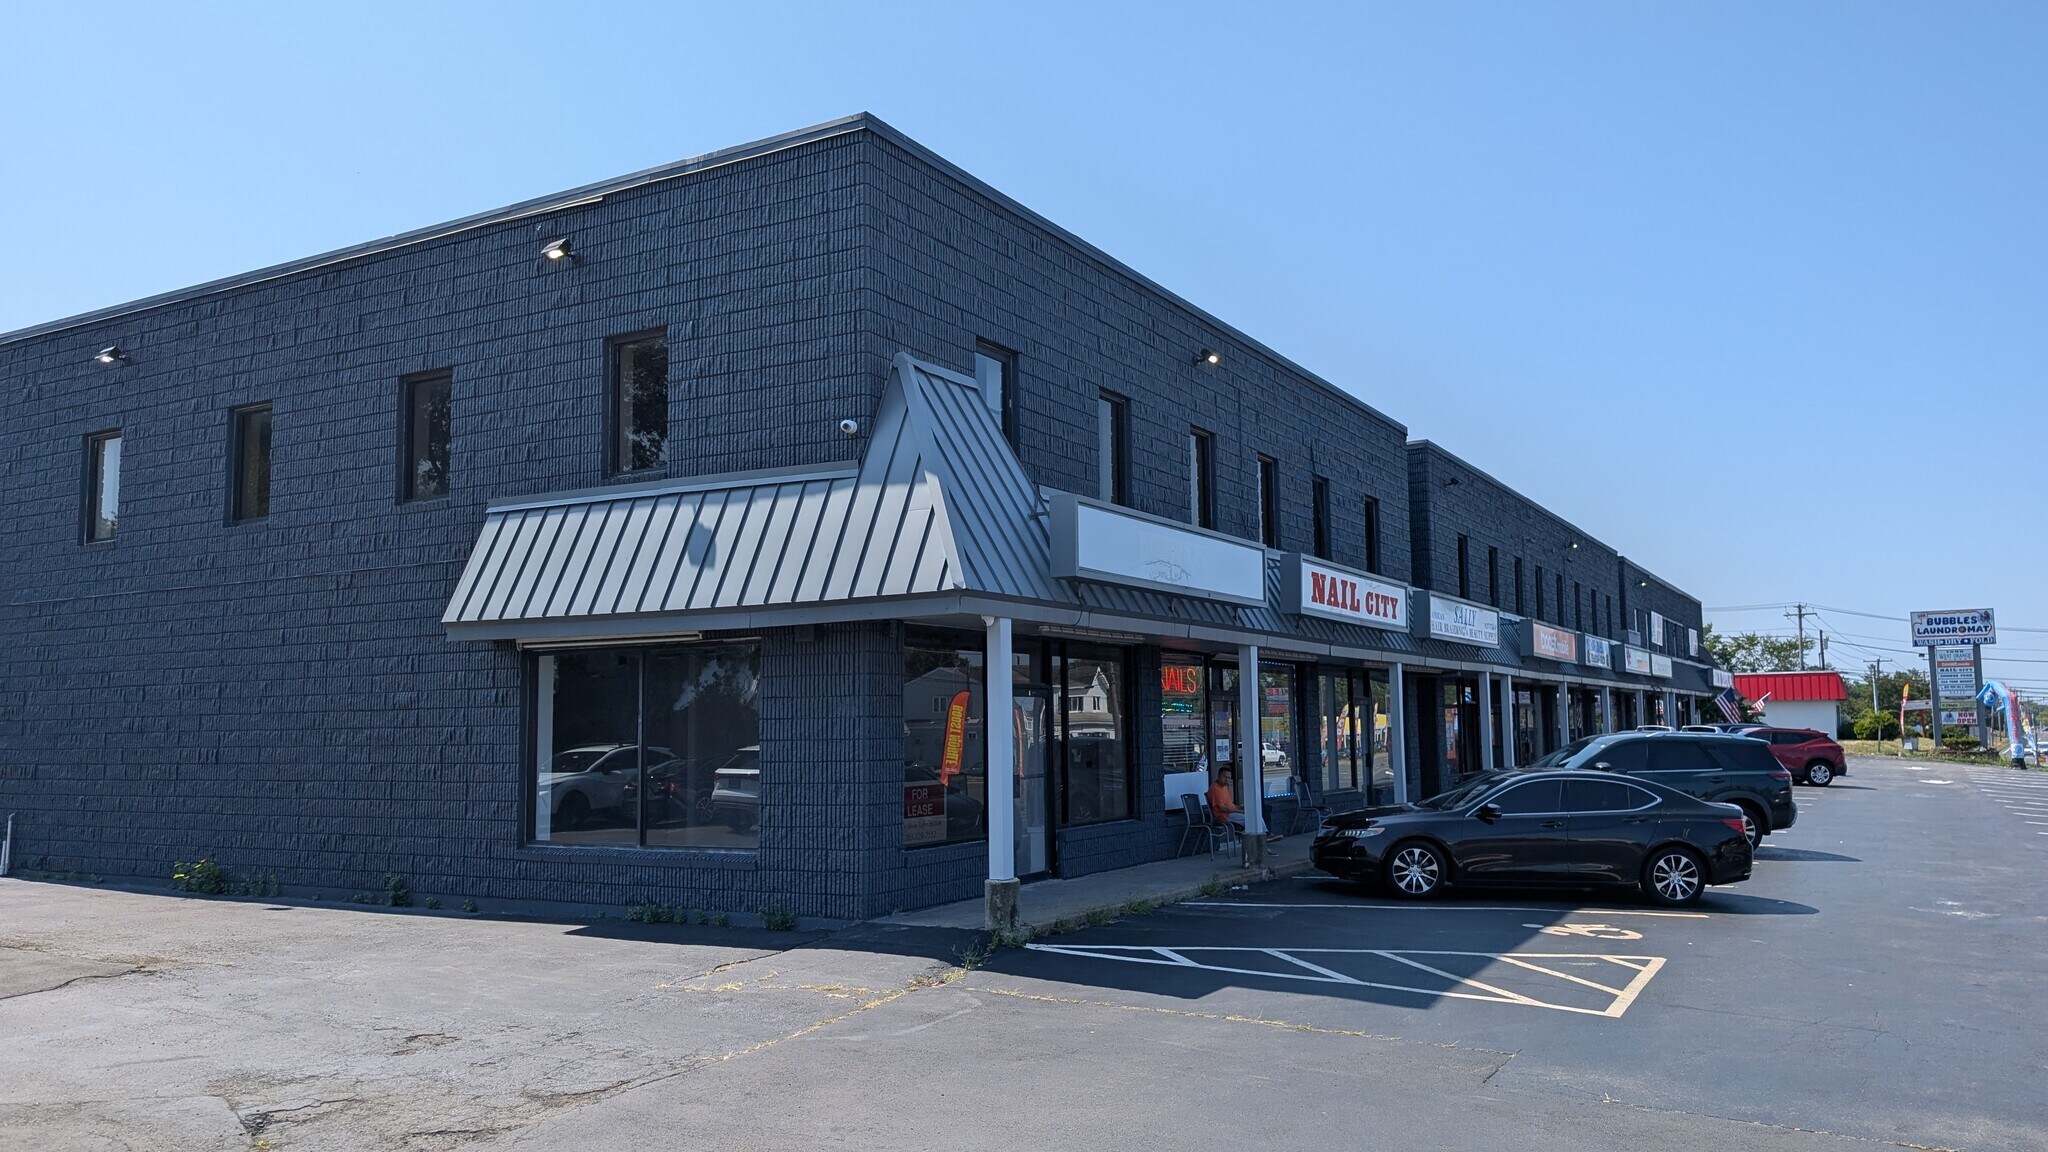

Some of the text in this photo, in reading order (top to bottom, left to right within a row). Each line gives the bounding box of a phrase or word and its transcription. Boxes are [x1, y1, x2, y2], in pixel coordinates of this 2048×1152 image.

[1311, 571, 1399, 620] NAIL CITY
[1453, 605, 1477, 627] SALLY
[1926, 616, 1978, 626] BUBBLES
[1432, 620, 1443, 633] HAIR
[1916, 625, 1990, 635] LAUNDROMAT
[1540, 629, 1557, 652] boost
[912, 788, 928, 800] FOR
[907, 803, 934, 817] LEASE
